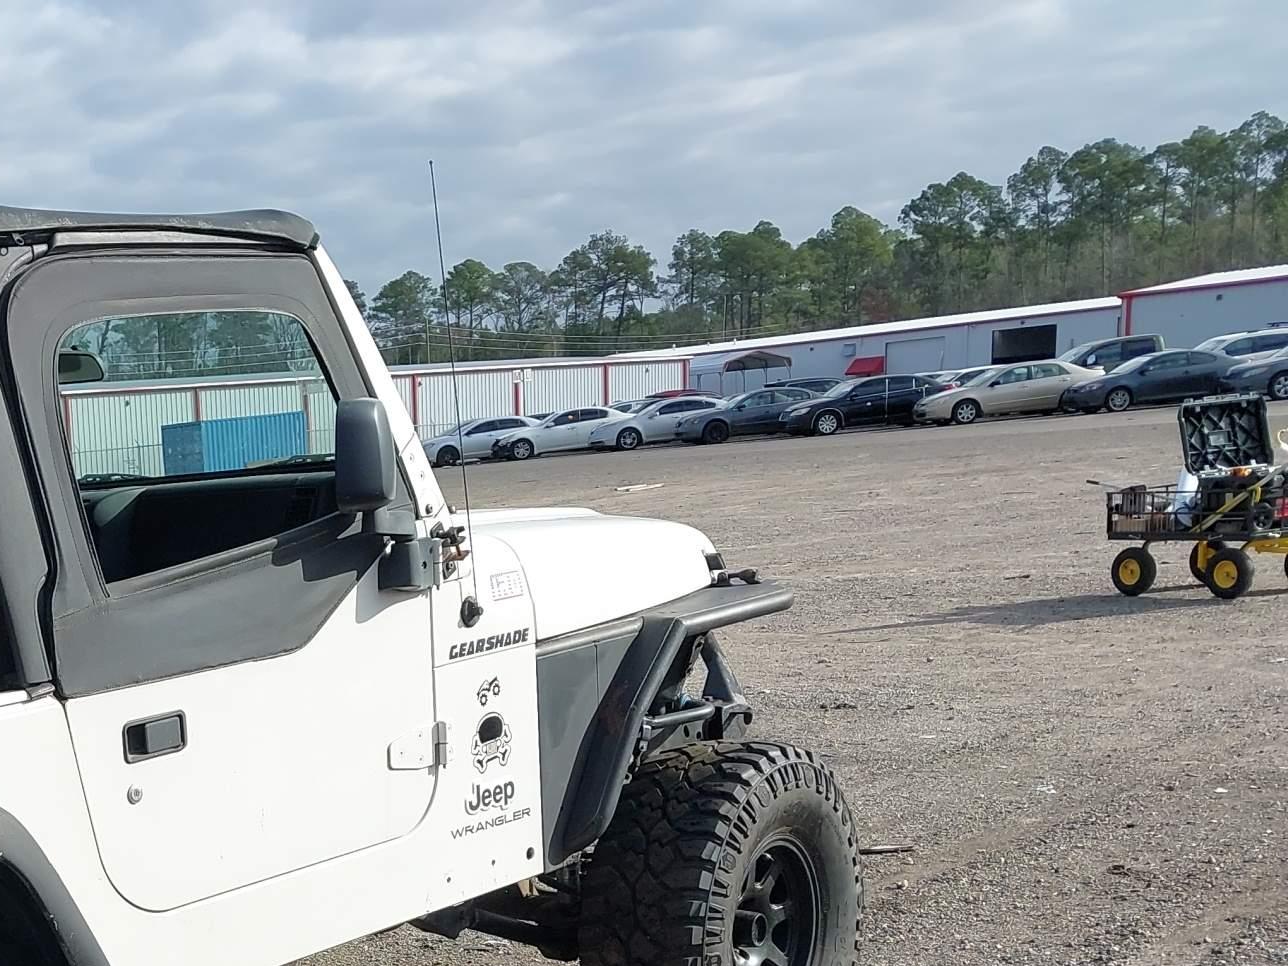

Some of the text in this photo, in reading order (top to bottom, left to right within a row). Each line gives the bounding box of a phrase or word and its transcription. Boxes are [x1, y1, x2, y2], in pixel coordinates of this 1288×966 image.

[449, 628, 530, 660] GEARSHADE
[468, 780, 515, 812] Jeep
[450, 807, 531, 840] WRANGLER
